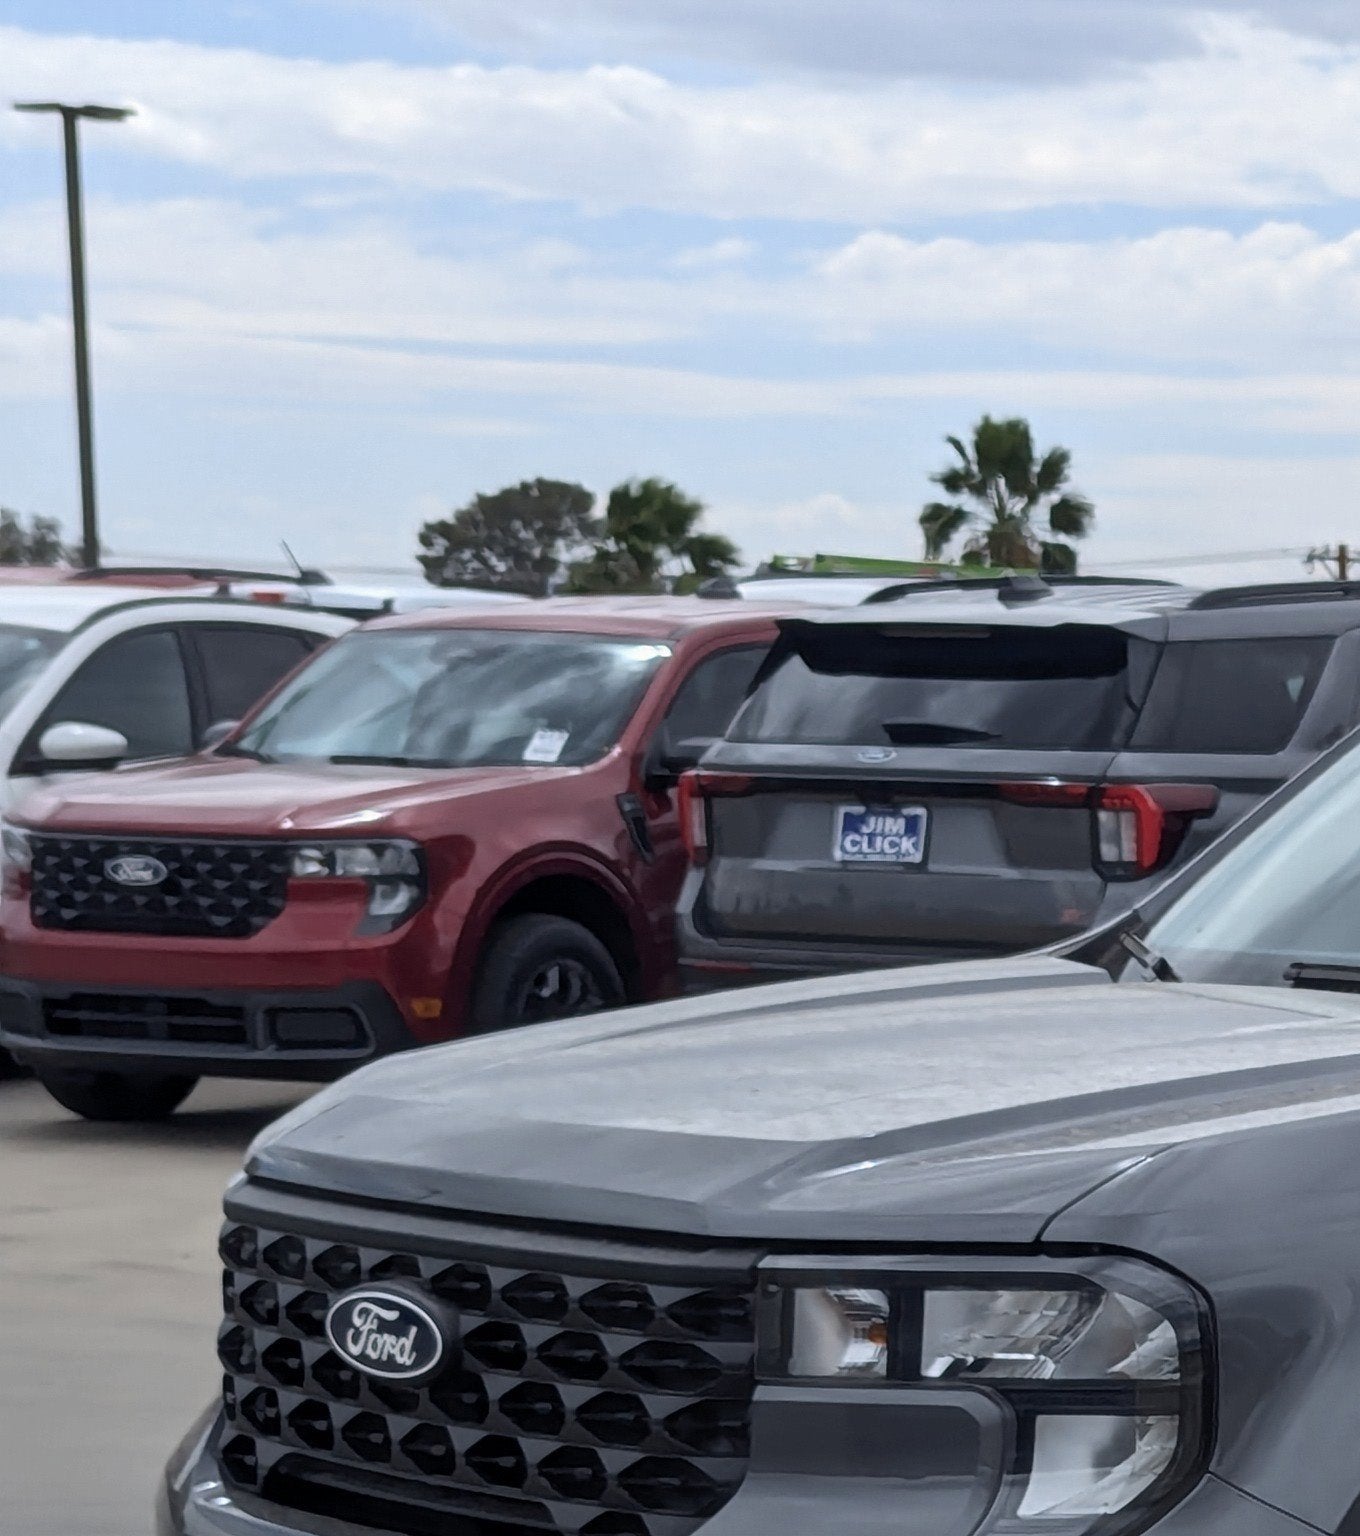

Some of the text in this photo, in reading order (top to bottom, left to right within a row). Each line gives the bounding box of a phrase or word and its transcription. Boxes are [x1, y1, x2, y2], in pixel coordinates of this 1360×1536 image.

[860, 816, 905, 834] JIM
[843, 834, 918, 854] CLICK
[346, 1301, 418, 1366] Ford
